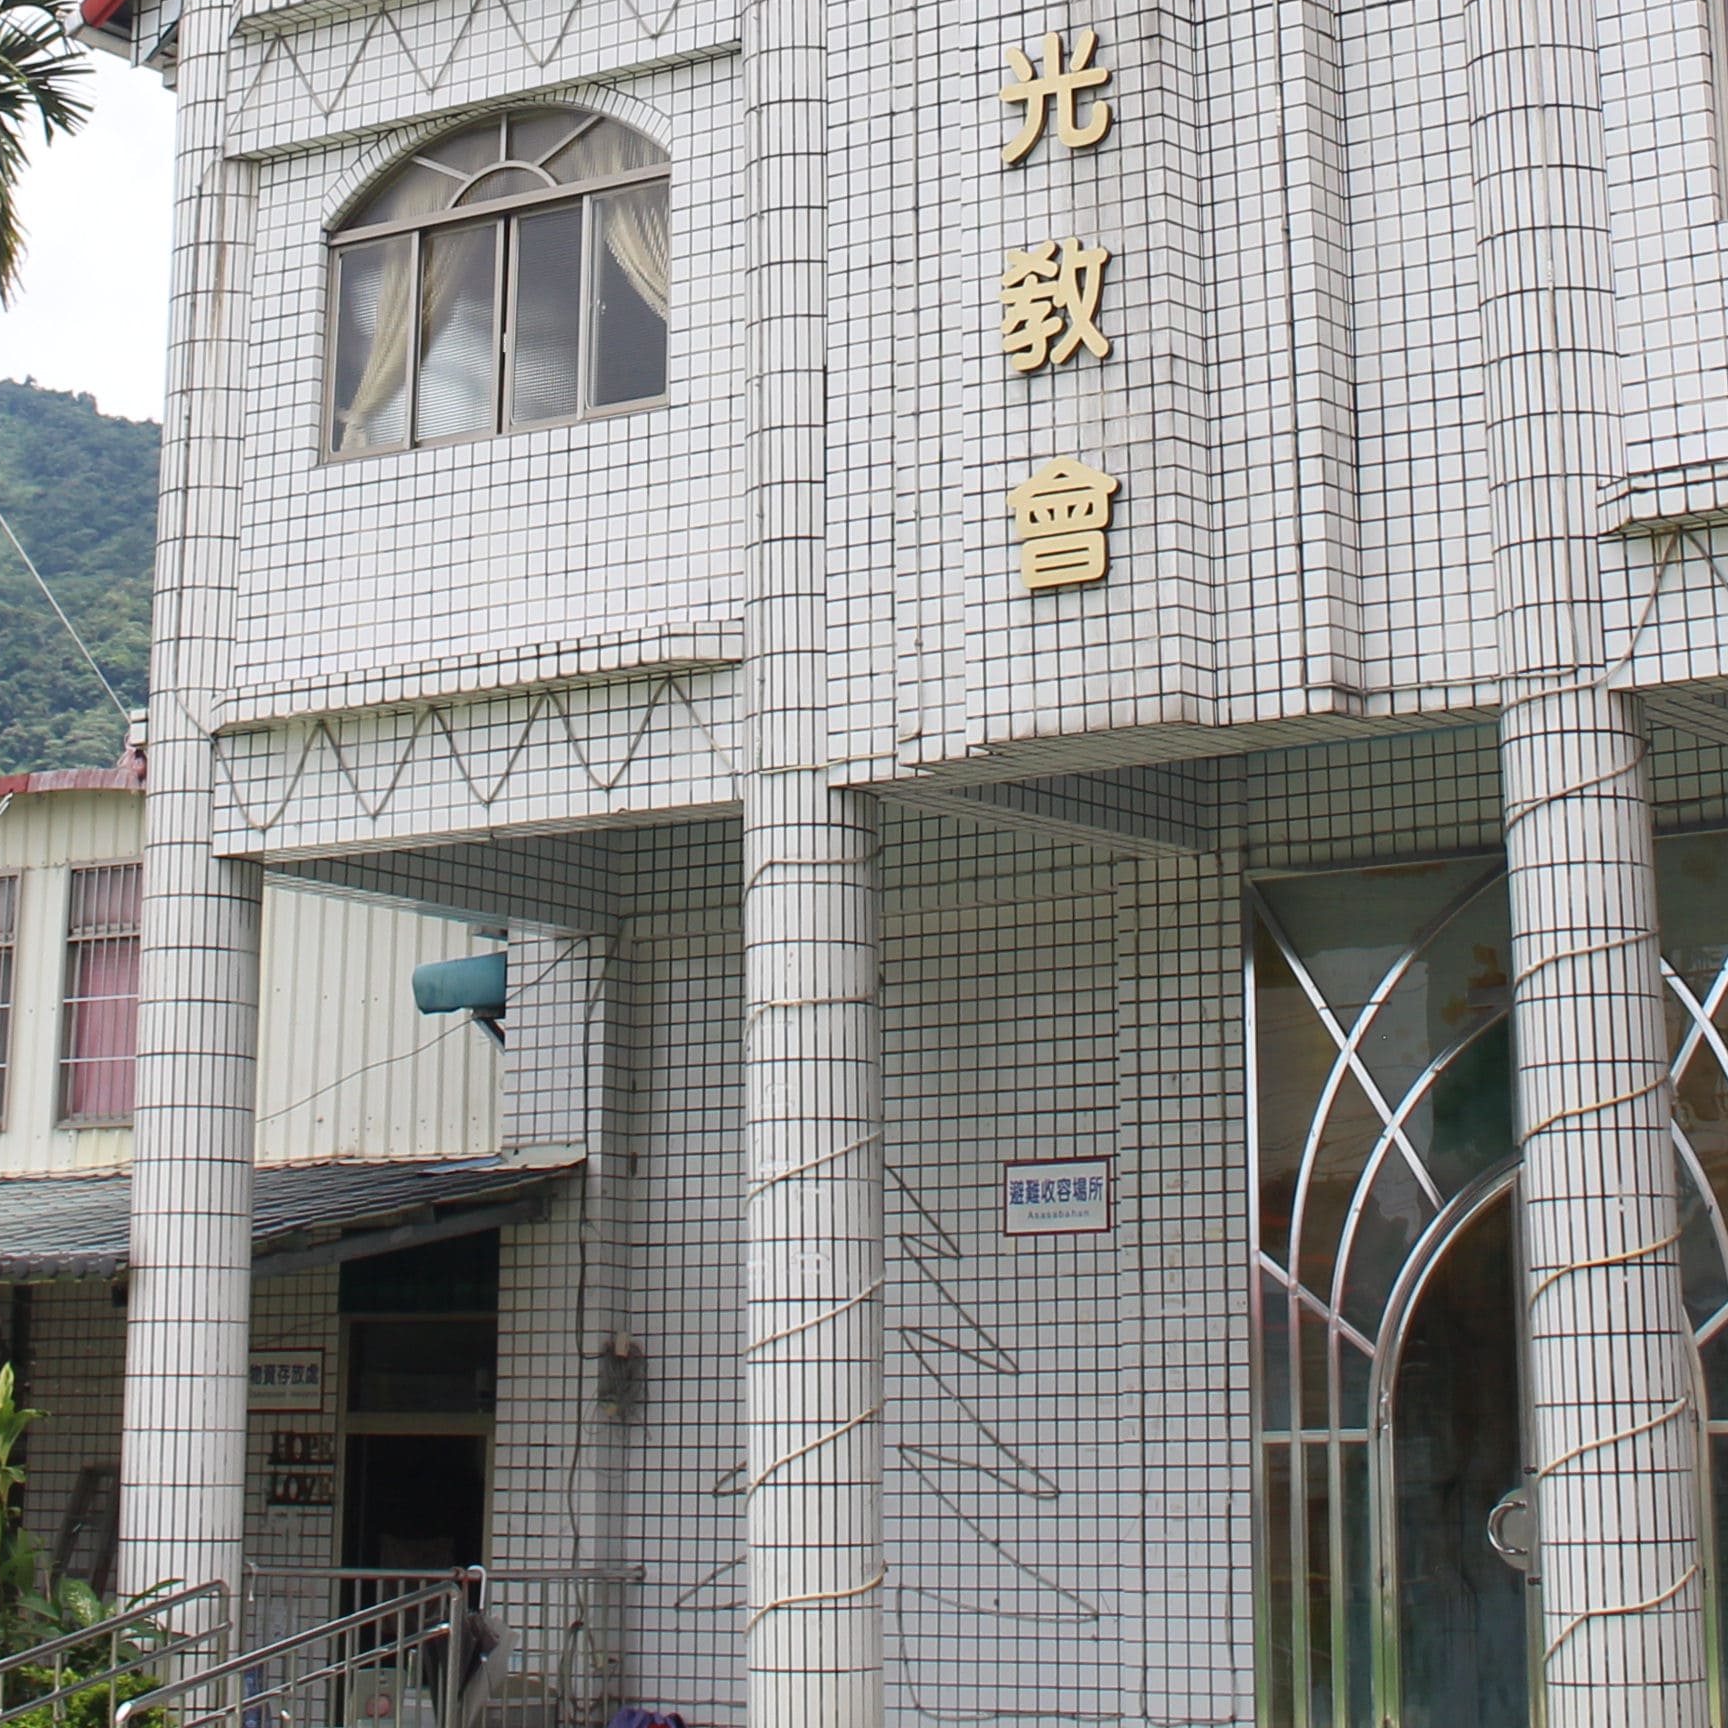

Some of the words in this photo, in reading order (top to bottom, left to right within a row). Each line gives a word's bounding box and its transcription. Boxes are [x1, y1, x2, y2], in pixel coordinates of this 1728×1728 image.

[1009, 1176, 1104, 1205] 避難收容場所
[272, 1432, 336, 1463] HOPE
[271, 1474, 333, 1503] LOVE
